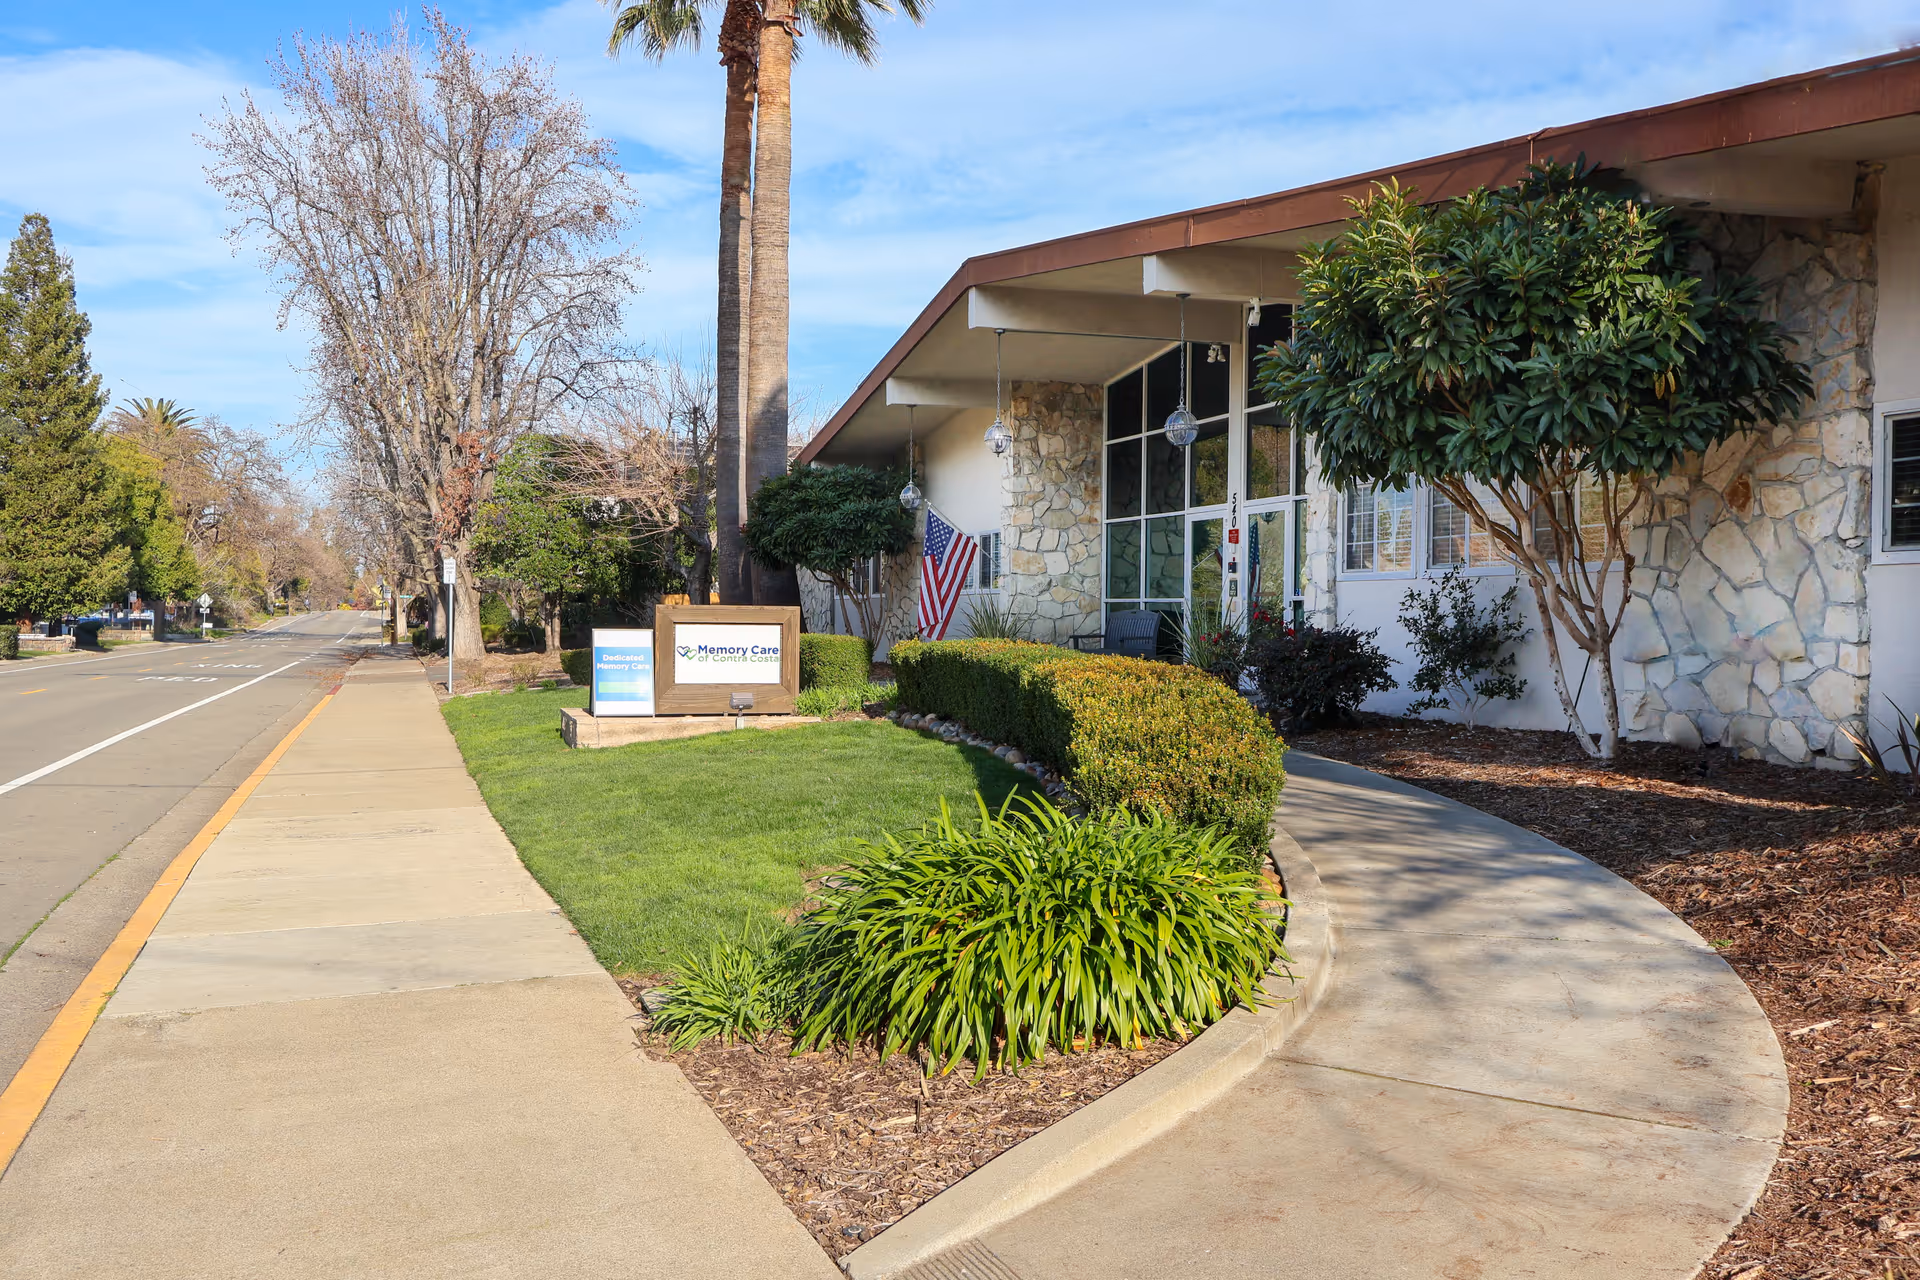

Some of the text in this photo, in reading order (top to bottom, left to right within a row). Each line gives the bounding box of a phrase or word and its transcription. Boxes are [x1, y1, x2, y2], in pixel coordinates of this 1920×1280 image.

[698, 645, 779, 656] Memory Care
[698, 654, 780, 662] of Contra Costa
[597, 663, 630, 671] Memory
